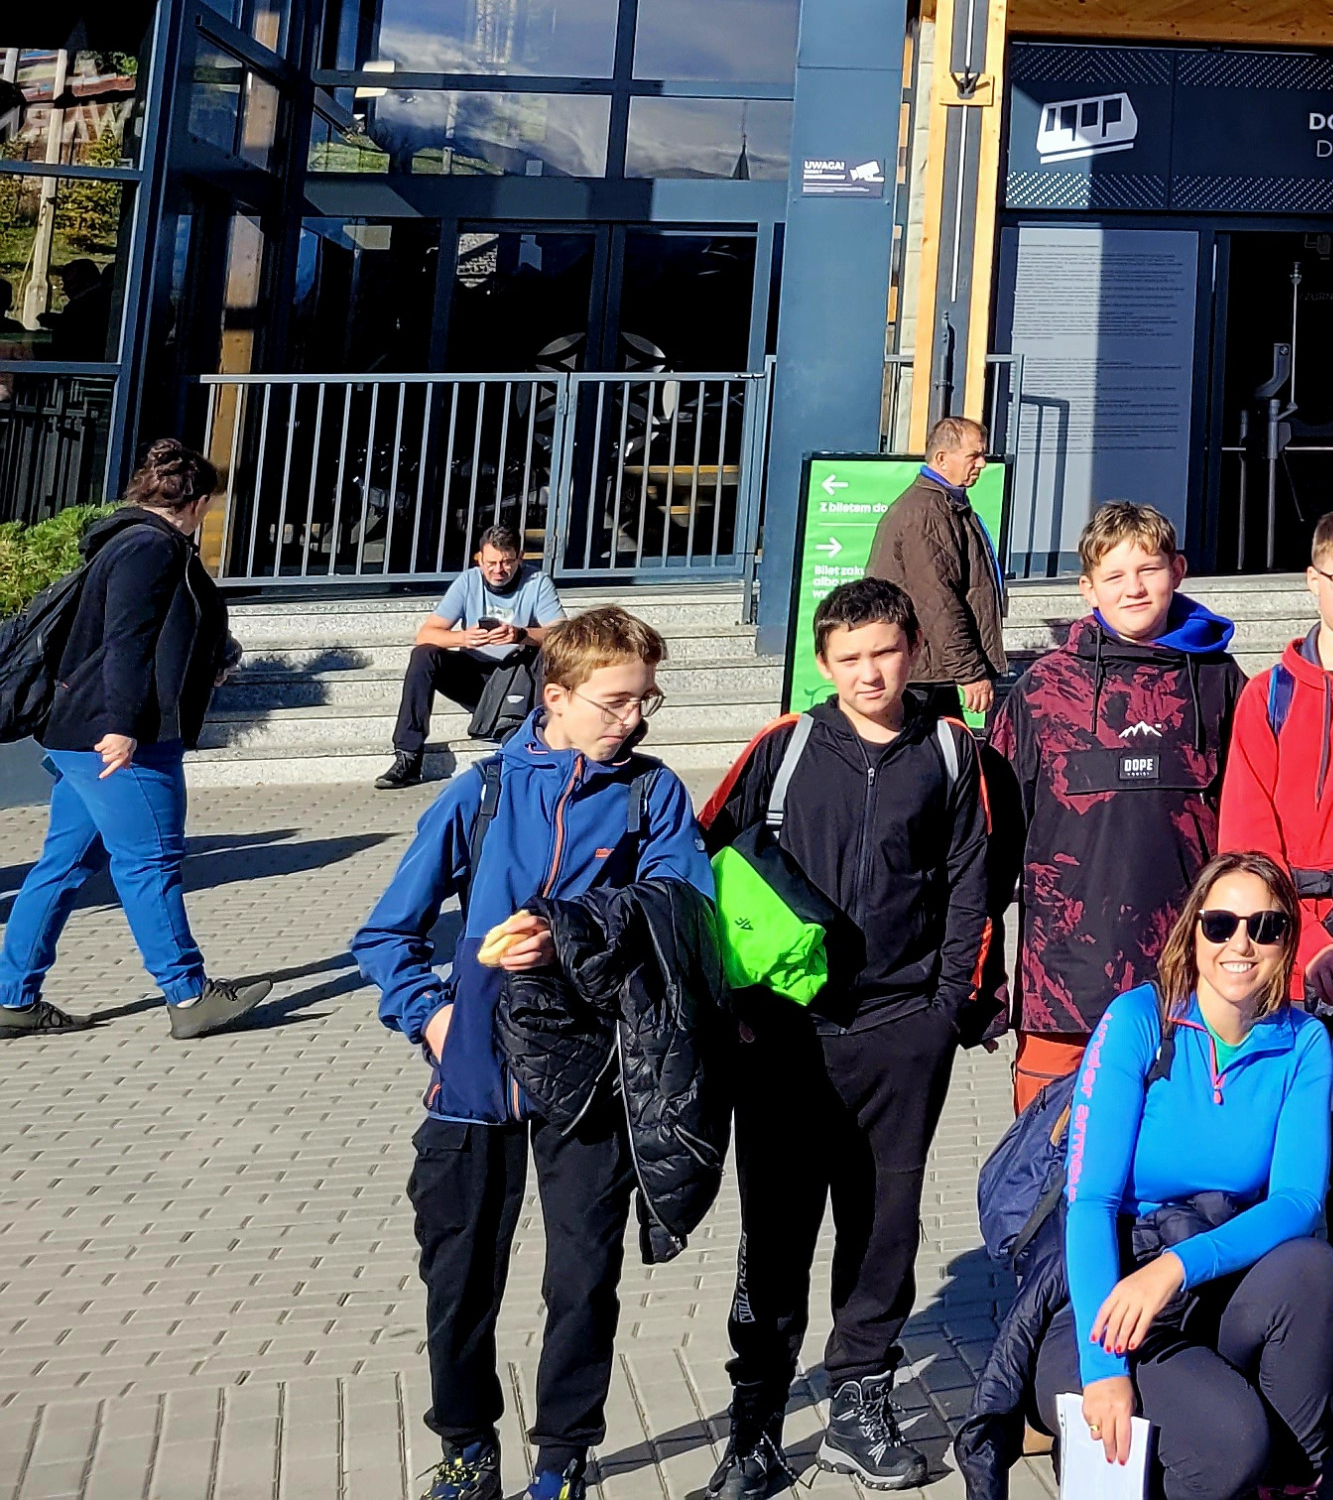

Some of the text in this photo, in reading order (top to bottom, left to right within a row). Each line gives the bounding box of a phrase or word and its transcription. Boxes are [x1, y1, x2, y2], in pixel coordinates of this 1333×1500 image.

[819, 502, 888, 513] Z biletem do
[814, 565, 840, 575] Bilet
[1124, 758, 1154, 772] DOPE
